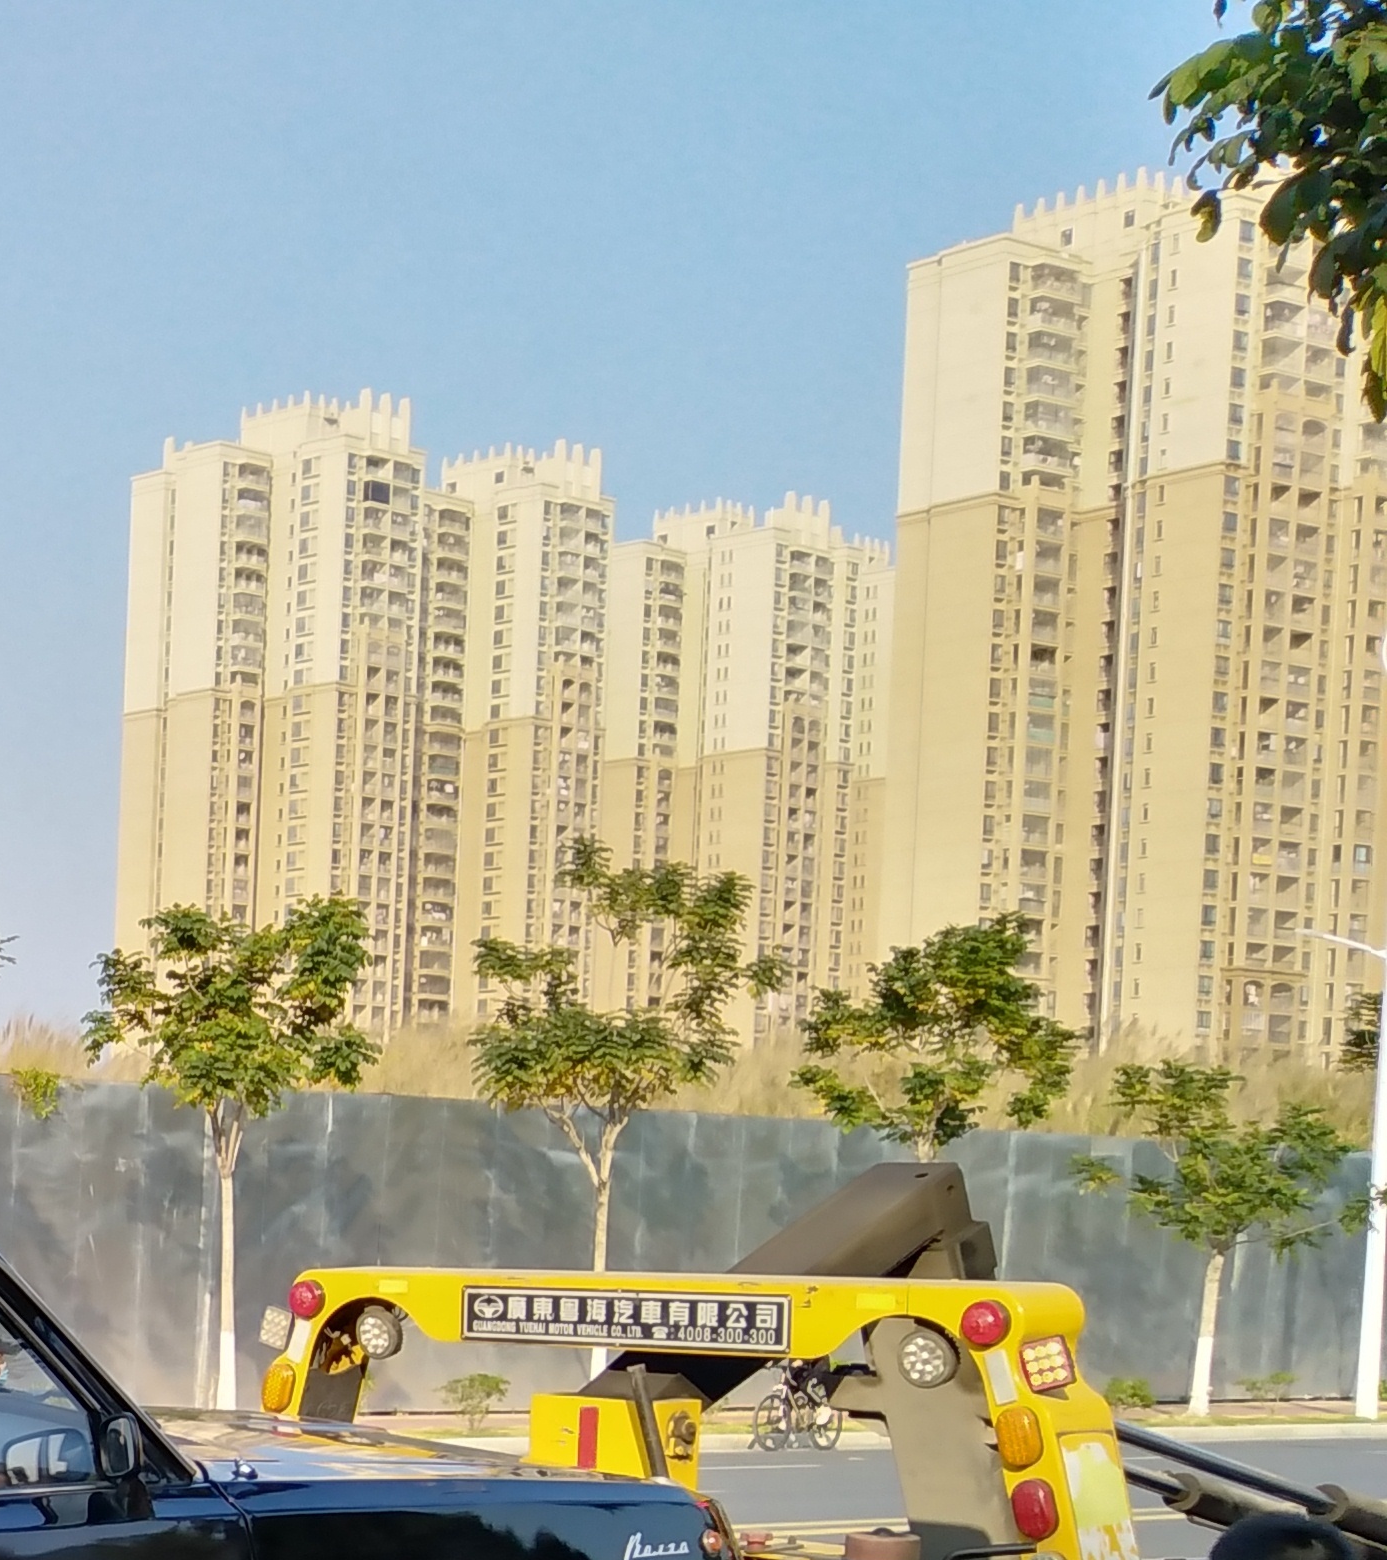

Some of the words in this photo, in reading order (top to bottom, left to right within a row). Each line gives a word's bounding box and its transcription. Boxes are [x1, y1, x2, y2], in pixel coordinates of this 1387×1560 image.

[473, 1320, 516, 1332] GUANGDONG
[519, 1321, 546, 1334] YUEHAI
[549, 1322, 574, 1336] MOTOR
[577, 1323, 608, 1337] VEHICLE
